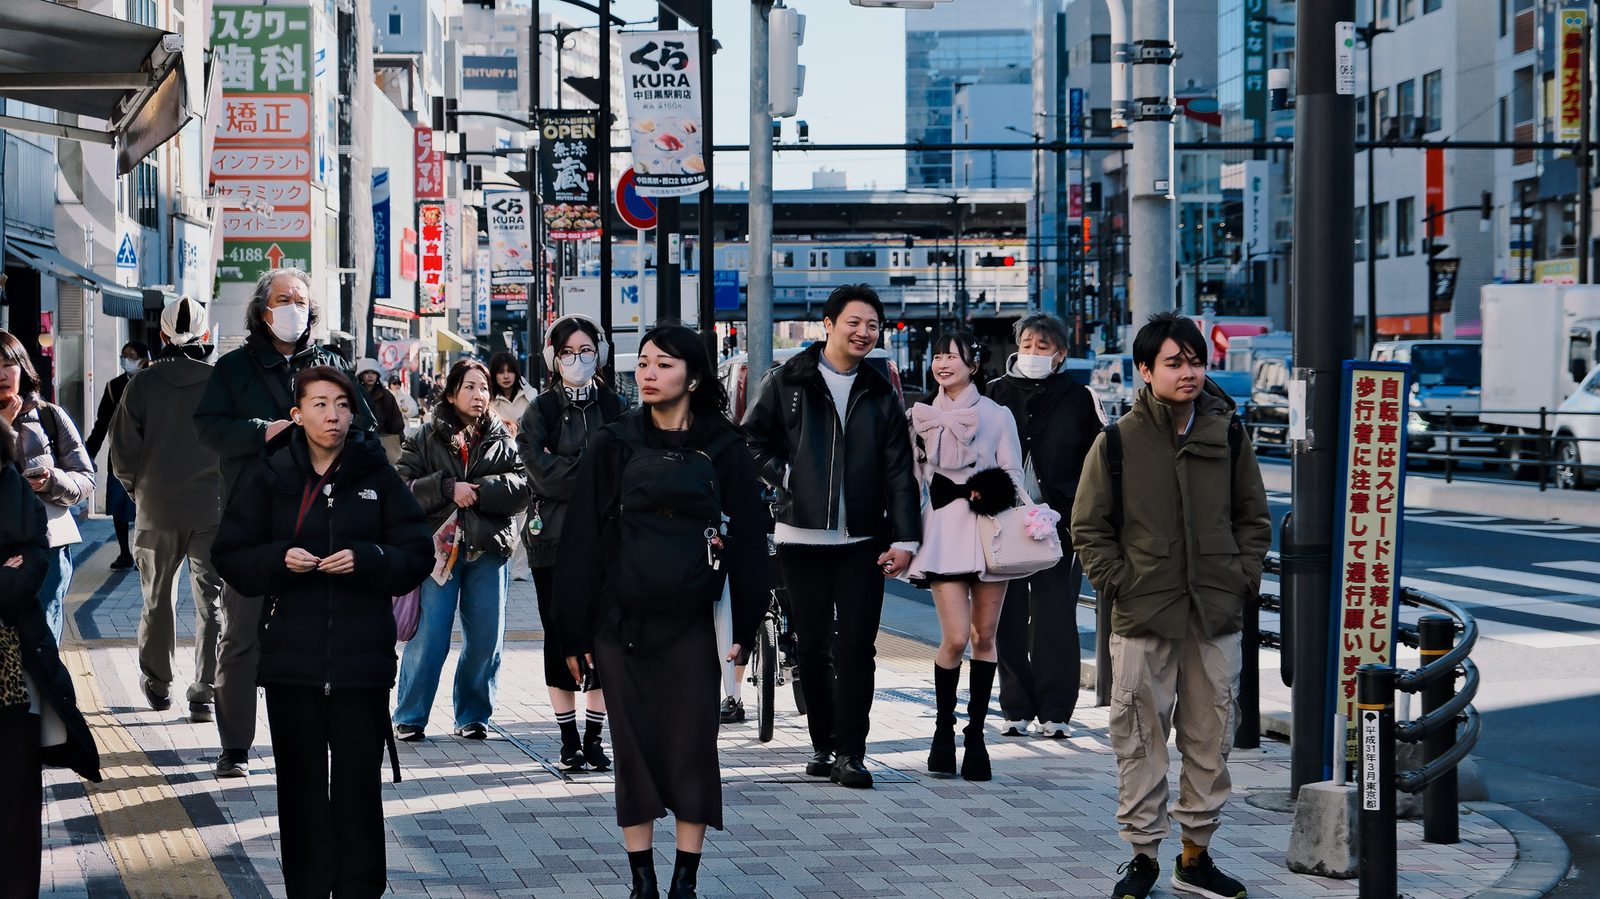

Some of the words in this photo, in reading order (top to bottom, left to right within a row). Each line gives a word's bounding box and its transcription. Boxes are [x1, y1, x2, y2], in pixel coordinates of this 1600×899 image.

[215, 43, 306, 91] 歯科
[630, 40, 688, 71] くら
[632, 74, 690, 88] KURA
[634, 90, 691, 100] 中目黒駅前店
[226, 102, 292, 133] 矯正
[543, 124, 596, 140] OPEN
[417, 130, 433, 193] ヒノマル
[491, 198, 524, 215] くら
[492, 215, 525, 225] KURA
[1368, 377, 1399, 663] 自転車はスピードを落とし、
[1364, 725, 1377, 809] 平成31年3月東京都
